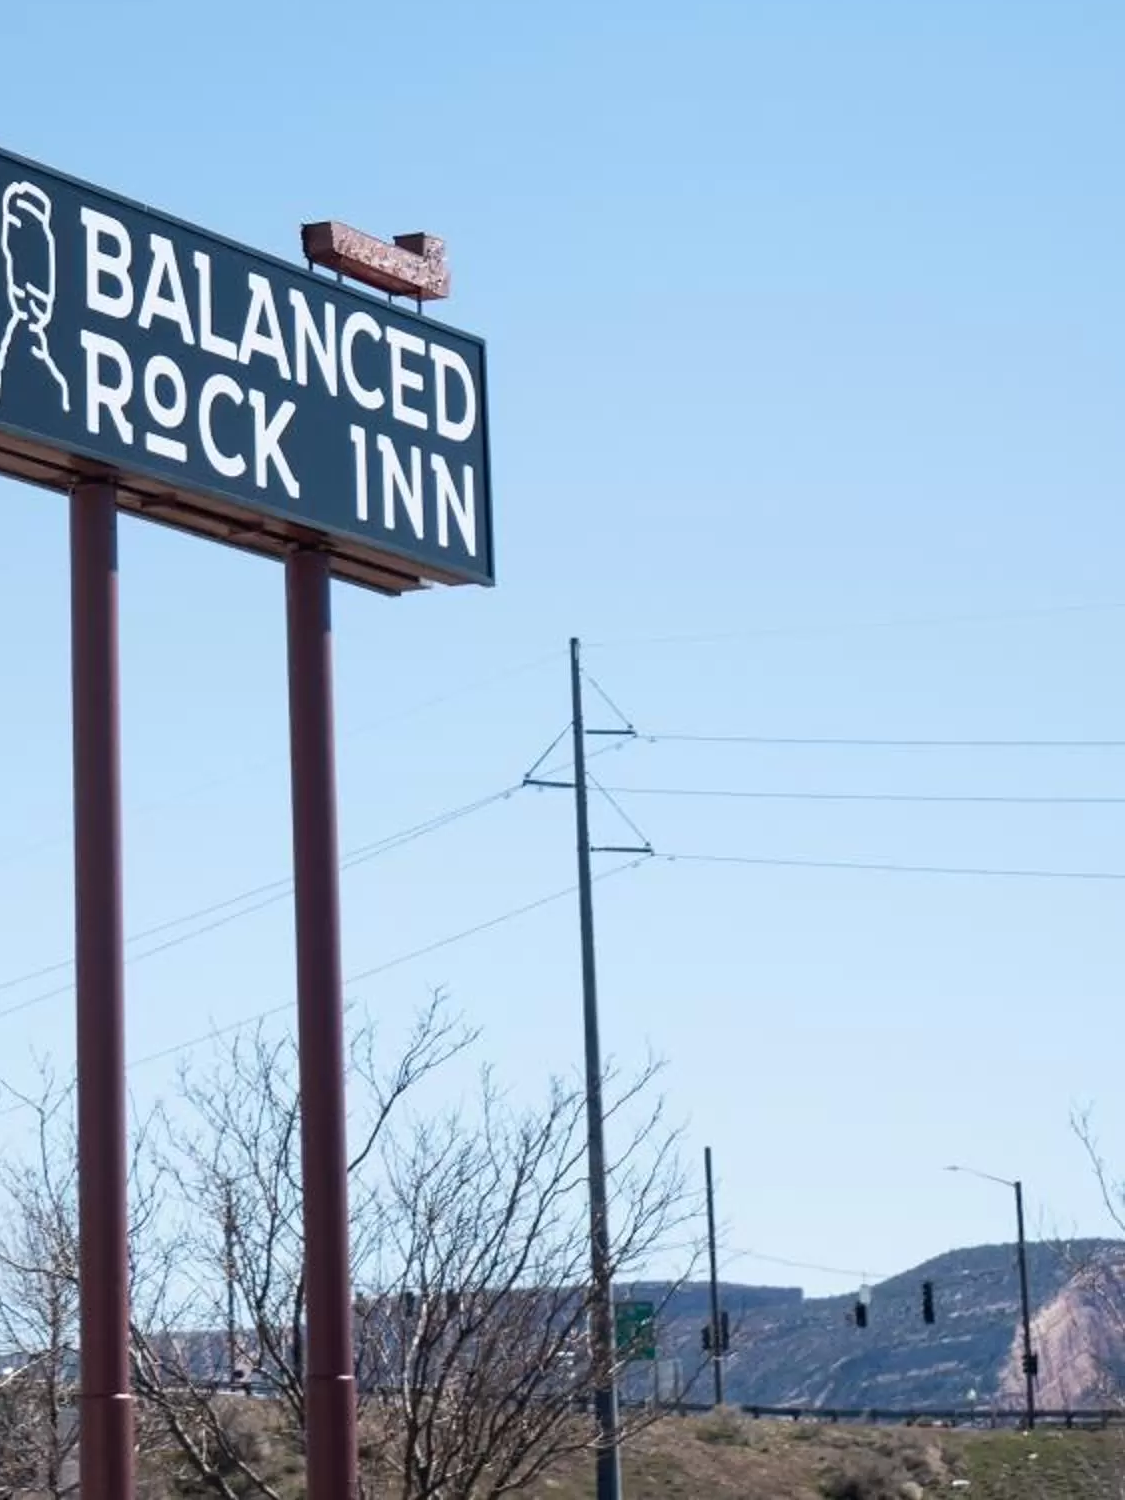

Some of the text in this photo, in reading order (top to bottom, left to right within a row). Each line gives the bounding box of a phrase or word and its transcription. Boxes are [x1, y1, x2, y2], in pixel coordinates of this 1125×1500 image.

[80, 206, 476, 442] BALANCED
[80, 329, 476, 557] ROCK INN
